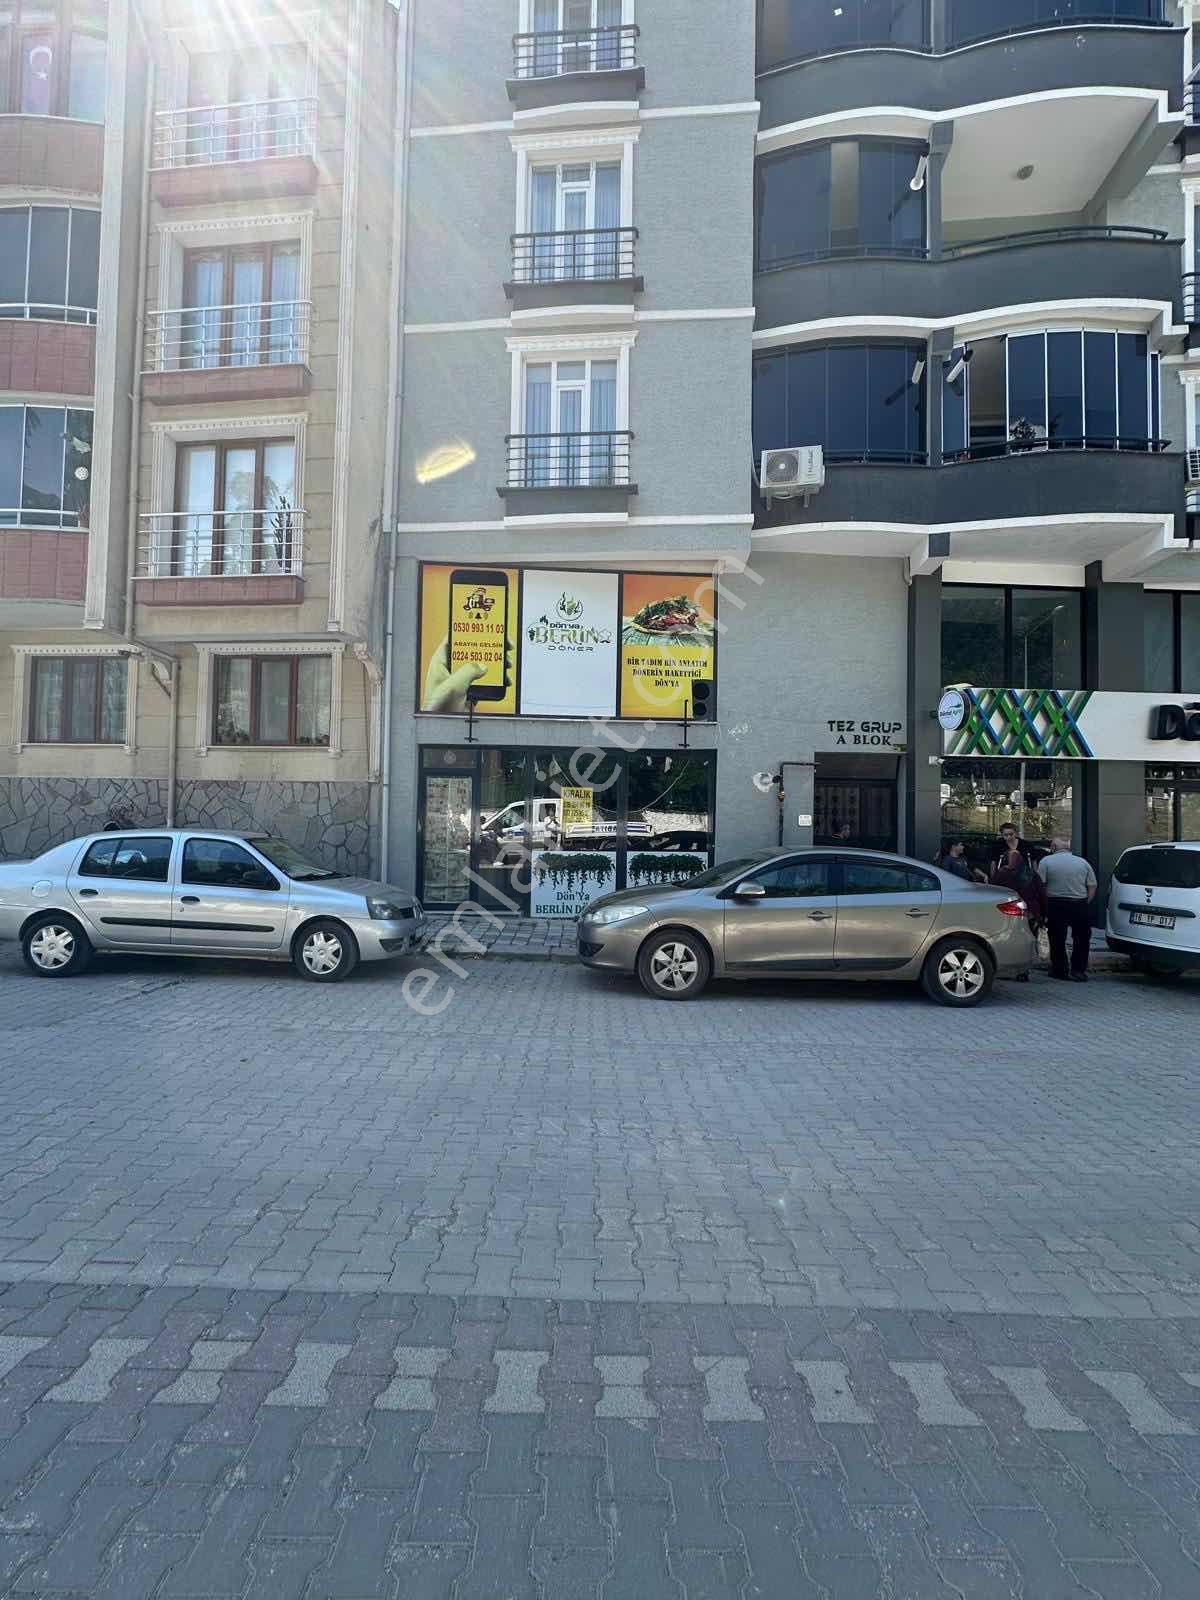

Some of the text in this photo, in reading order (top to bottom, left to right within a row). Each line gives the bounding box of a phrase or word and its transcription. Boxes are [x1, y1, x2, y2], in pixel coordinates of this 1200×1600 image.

[453, 622, 469, 632] 0530
[471, 623, 484, 632] 993
[486, 624, 494, 632] 11
[452, 651, 503, 662] 0224 503 02 04
[827, 720, 902, 733] TEZ GRUP
[836, 735, 891, 746] A BLOK
[535, 902, 573, 914] BERLİN
